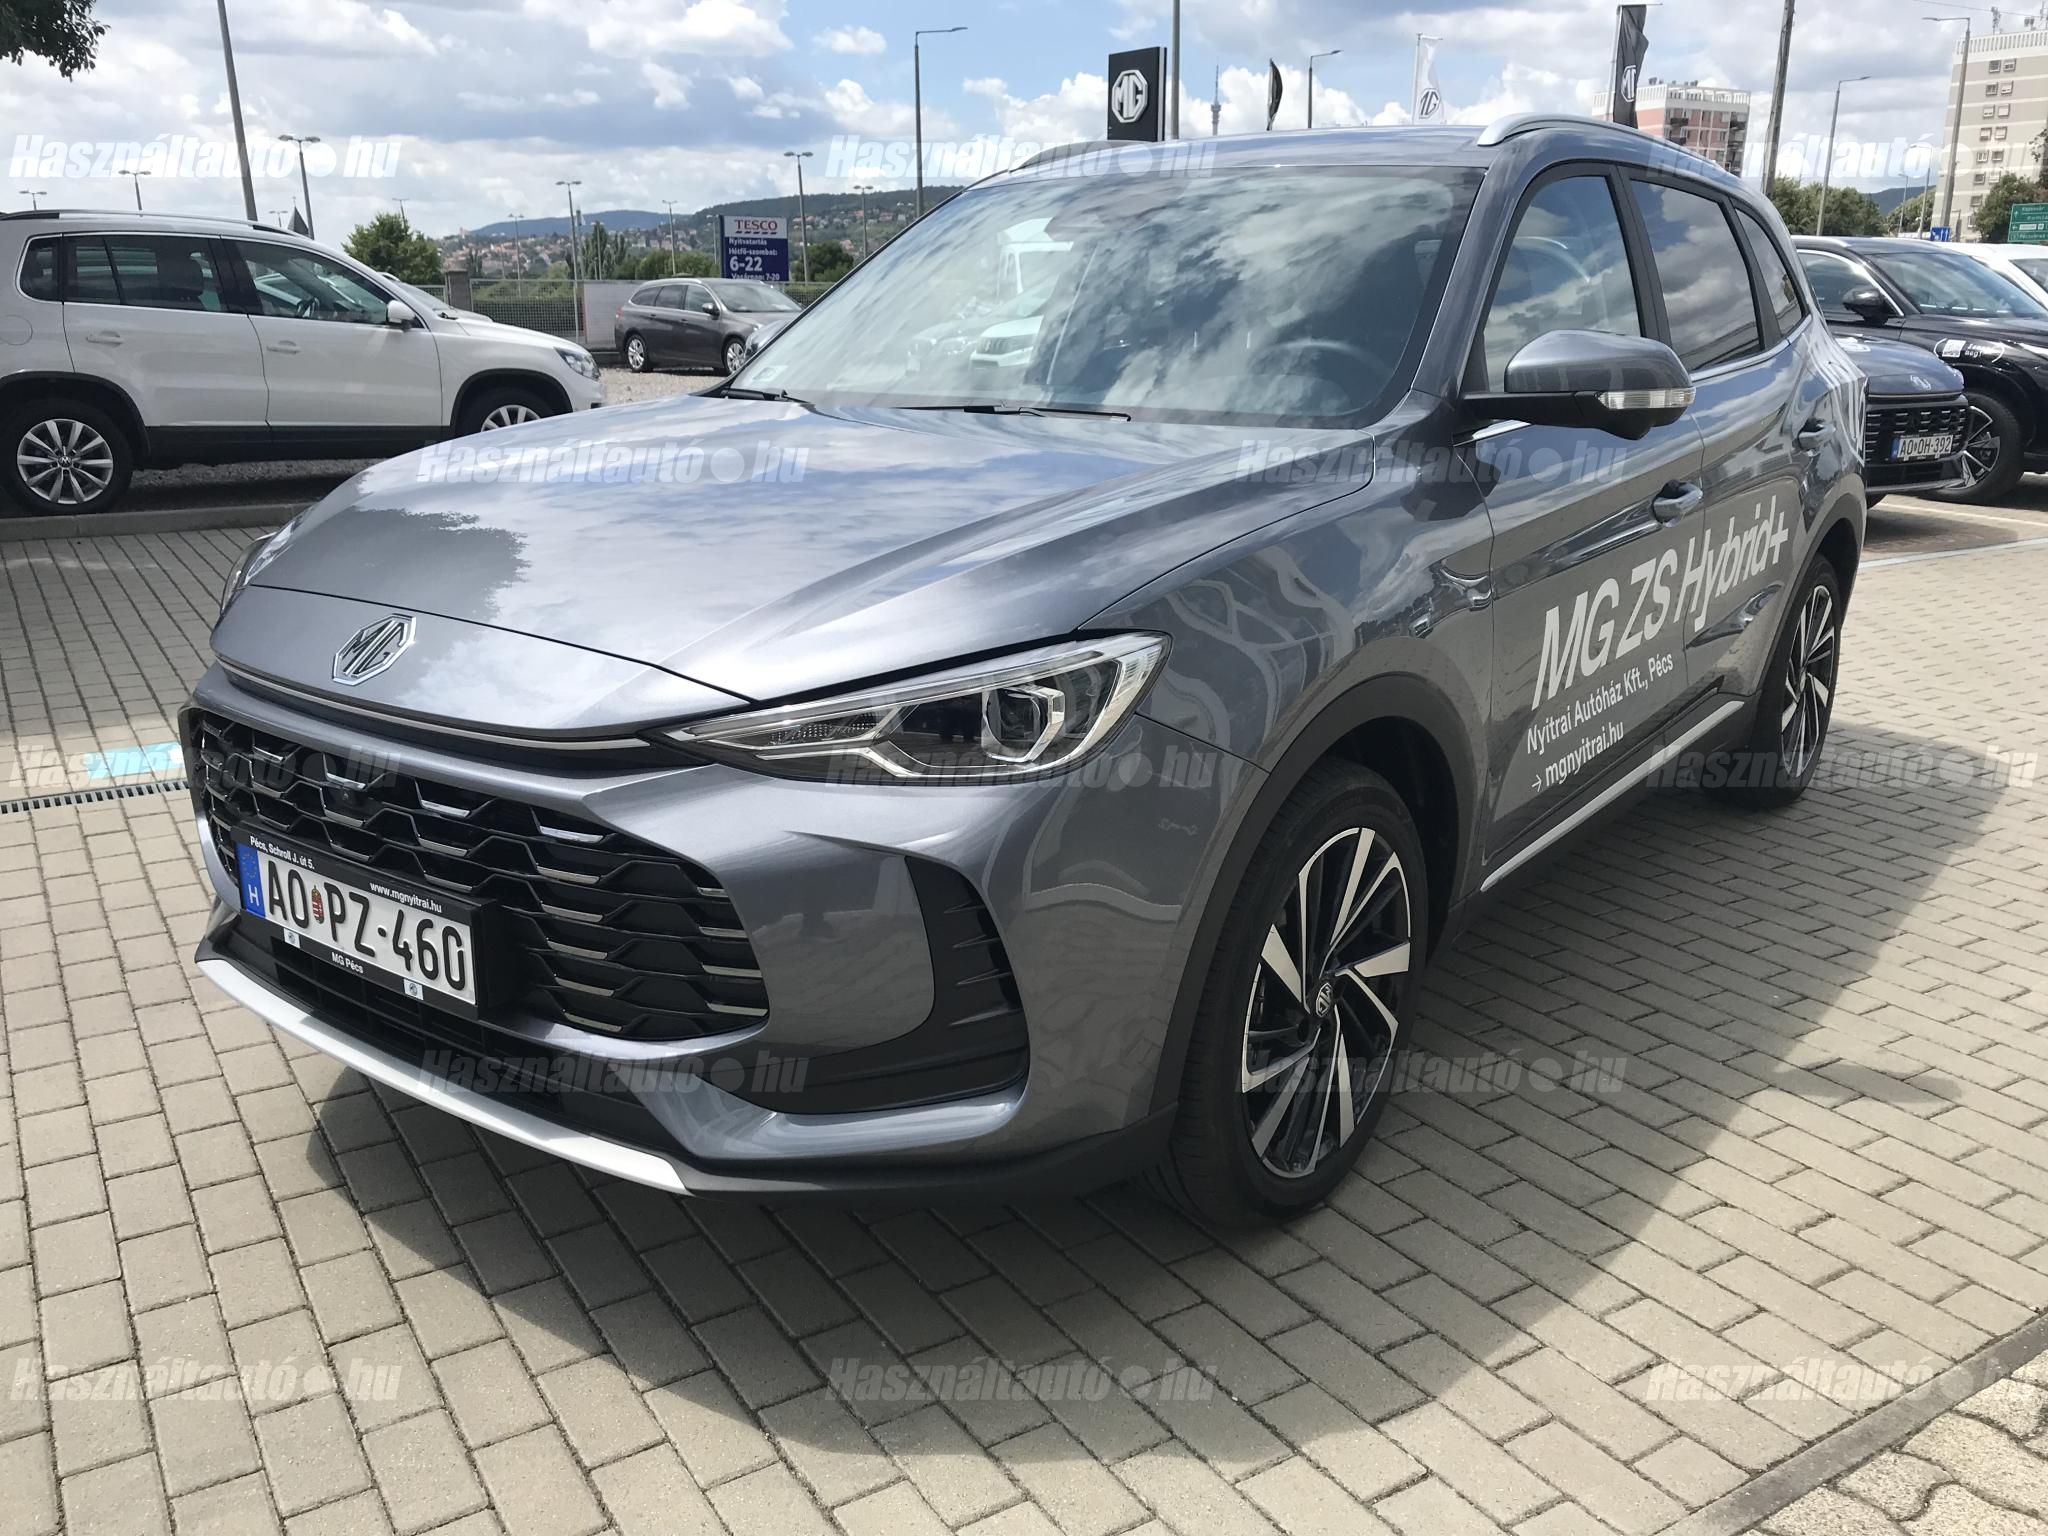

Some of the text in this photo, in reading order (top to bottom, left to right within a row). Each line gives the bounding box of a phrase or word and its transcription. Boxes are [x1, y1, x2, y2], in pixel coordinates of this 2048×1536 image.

[1114, 73, 1144, 120] MG
[735, 219, 778, 231] TESCO
[729, 255, 763, 272] 6-22
[1900, 439, 1914, 456] AO
[1531, 495, 1788, 711] MG ZS Hybrid+
[337, 617, 411, 682] MG
[1527, 653, 1673, 754] Nyitrai Autóház Kft., Pécs
[1545, 720, 1624, 786] mgnyitrai.hu
[250, 835, 268, 853] Pécs,
[268, 843, 292, 861] Schroll
[292, 854, 300, 866] J.
[248, 883, 260, 907] H
[369, 882, 442, 914] www.mgnyitrai.hu
[268, 860, 466, 991] AO PZ-460
[331, 951, 364, 975] MG Pécs
